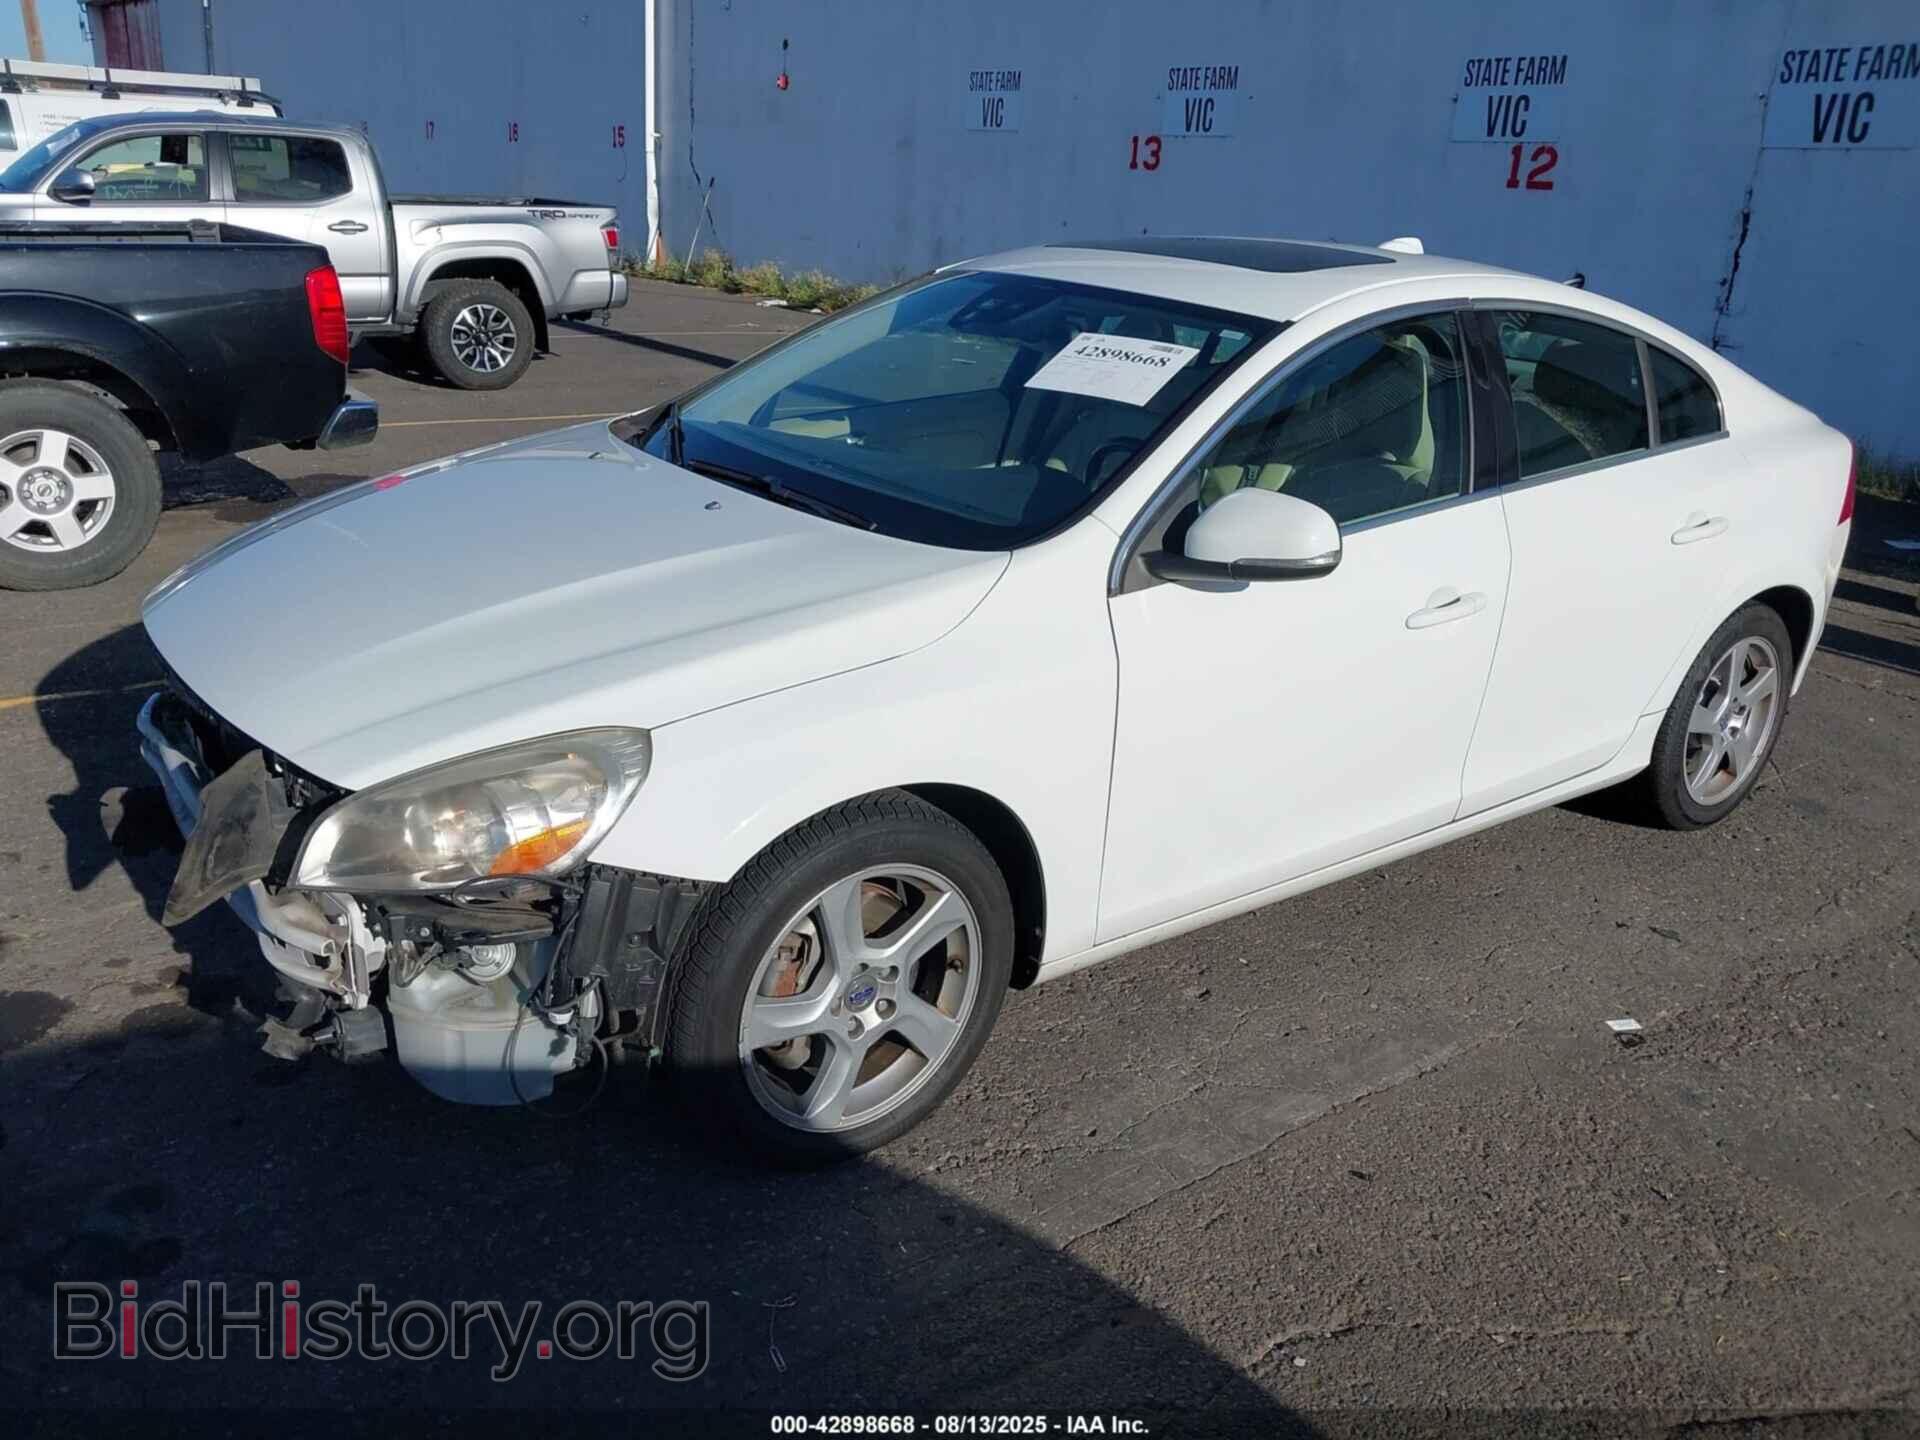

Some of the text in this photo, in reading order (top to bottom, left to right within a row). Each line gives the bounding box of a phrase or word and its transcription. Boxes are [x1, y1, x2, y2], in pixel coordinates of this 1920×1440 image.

[969, 70, 1022, 92] STATE FARM
[1168, 65, 1239, 91] STATE FARM
[1464, 55, 1568, 87] STATE FARM
[1780, 48, 1852, 84] STATE
[982, 97, 1004, 128] VIC
[1184, 97, 1215, 133] VIC
[1486, 94, 1531, 138] VIC
[1812, 92, 1875, 144] VIC
[611, 125, 625, 149] 15
[1129, 135, 1162, 171] 13
[1506, 144, 1558, 191] 12
[527, 209, 566, 220] TRD
[1073, 344, 1171, 368] 42898668
